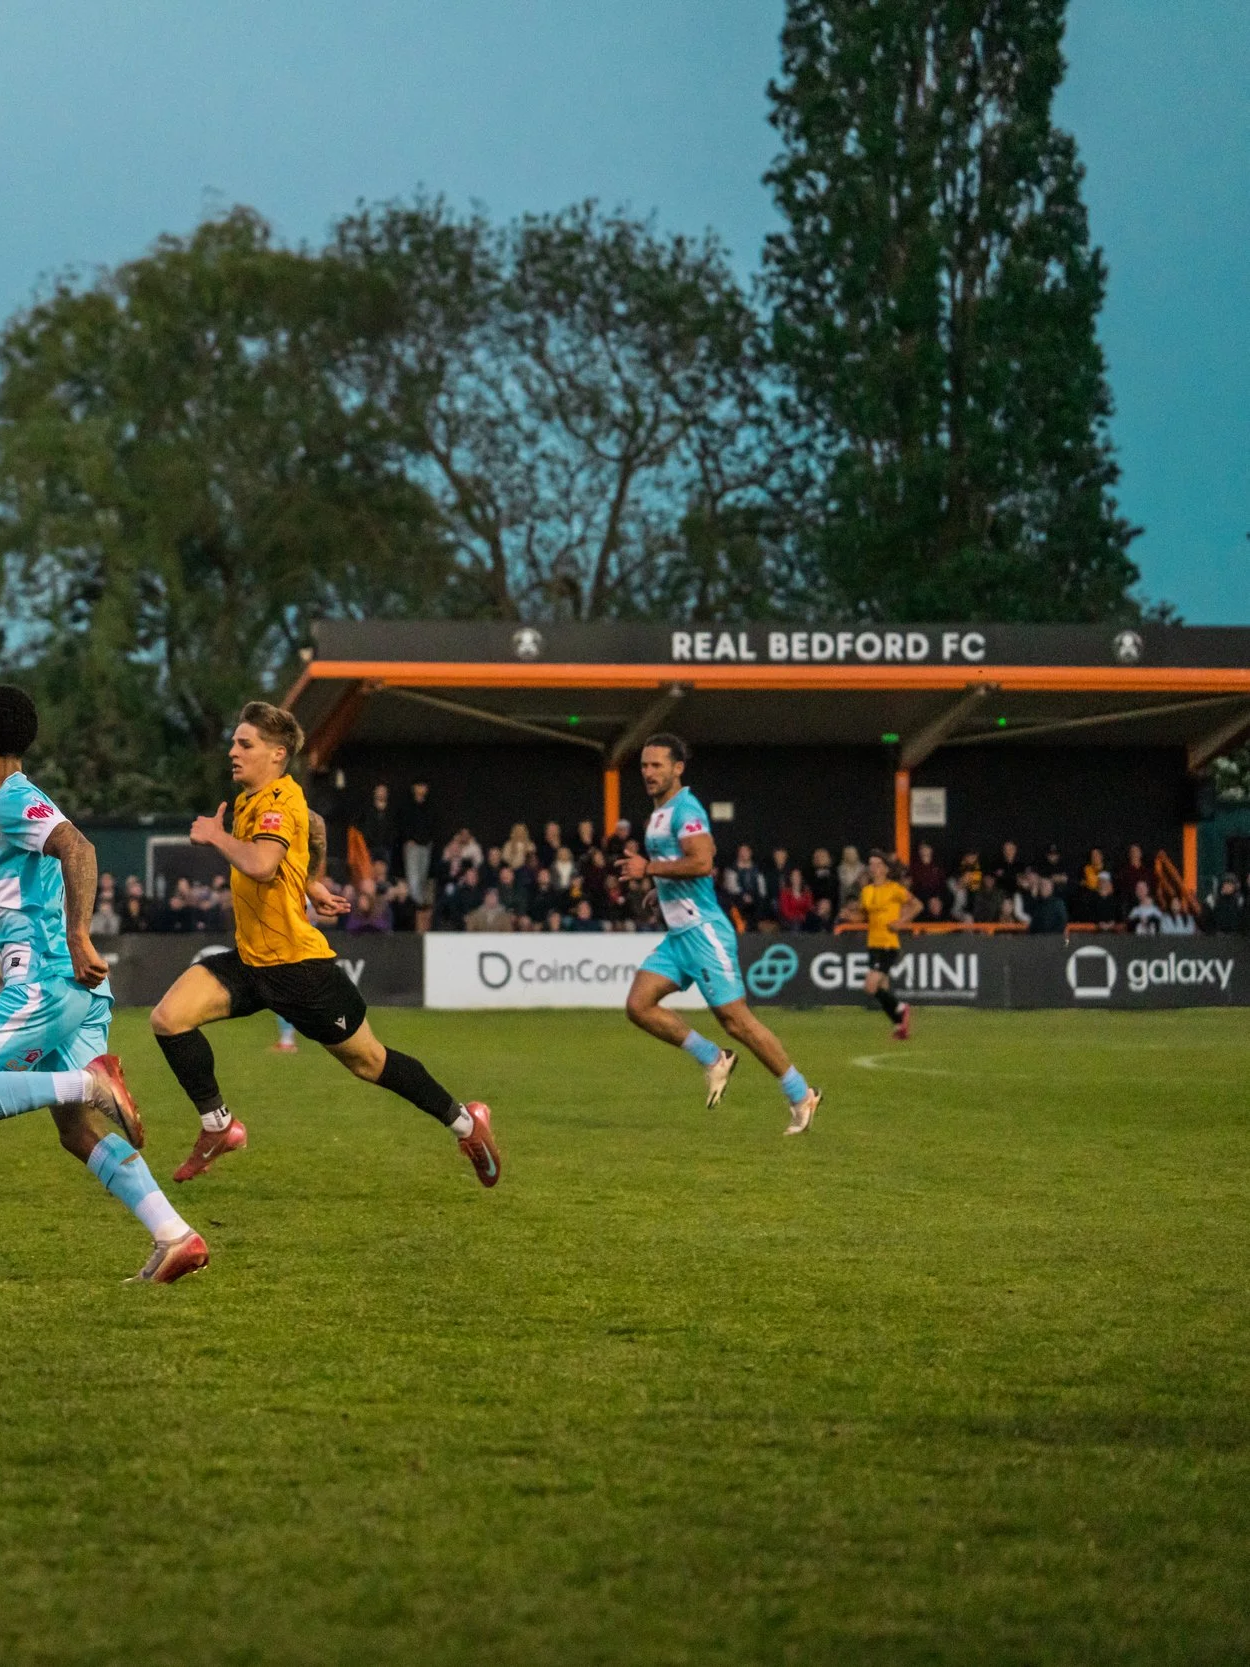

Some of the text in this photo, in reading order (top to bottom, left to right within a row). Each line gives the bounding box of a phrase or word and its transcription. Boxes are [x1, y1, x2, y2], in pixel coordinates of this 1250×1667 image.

[671, 632, 987, 661] REAL BEDFORD FC
[518, 958, 637, 983] CoinCorn
[1127, 951, 1234, 992] galaxy
